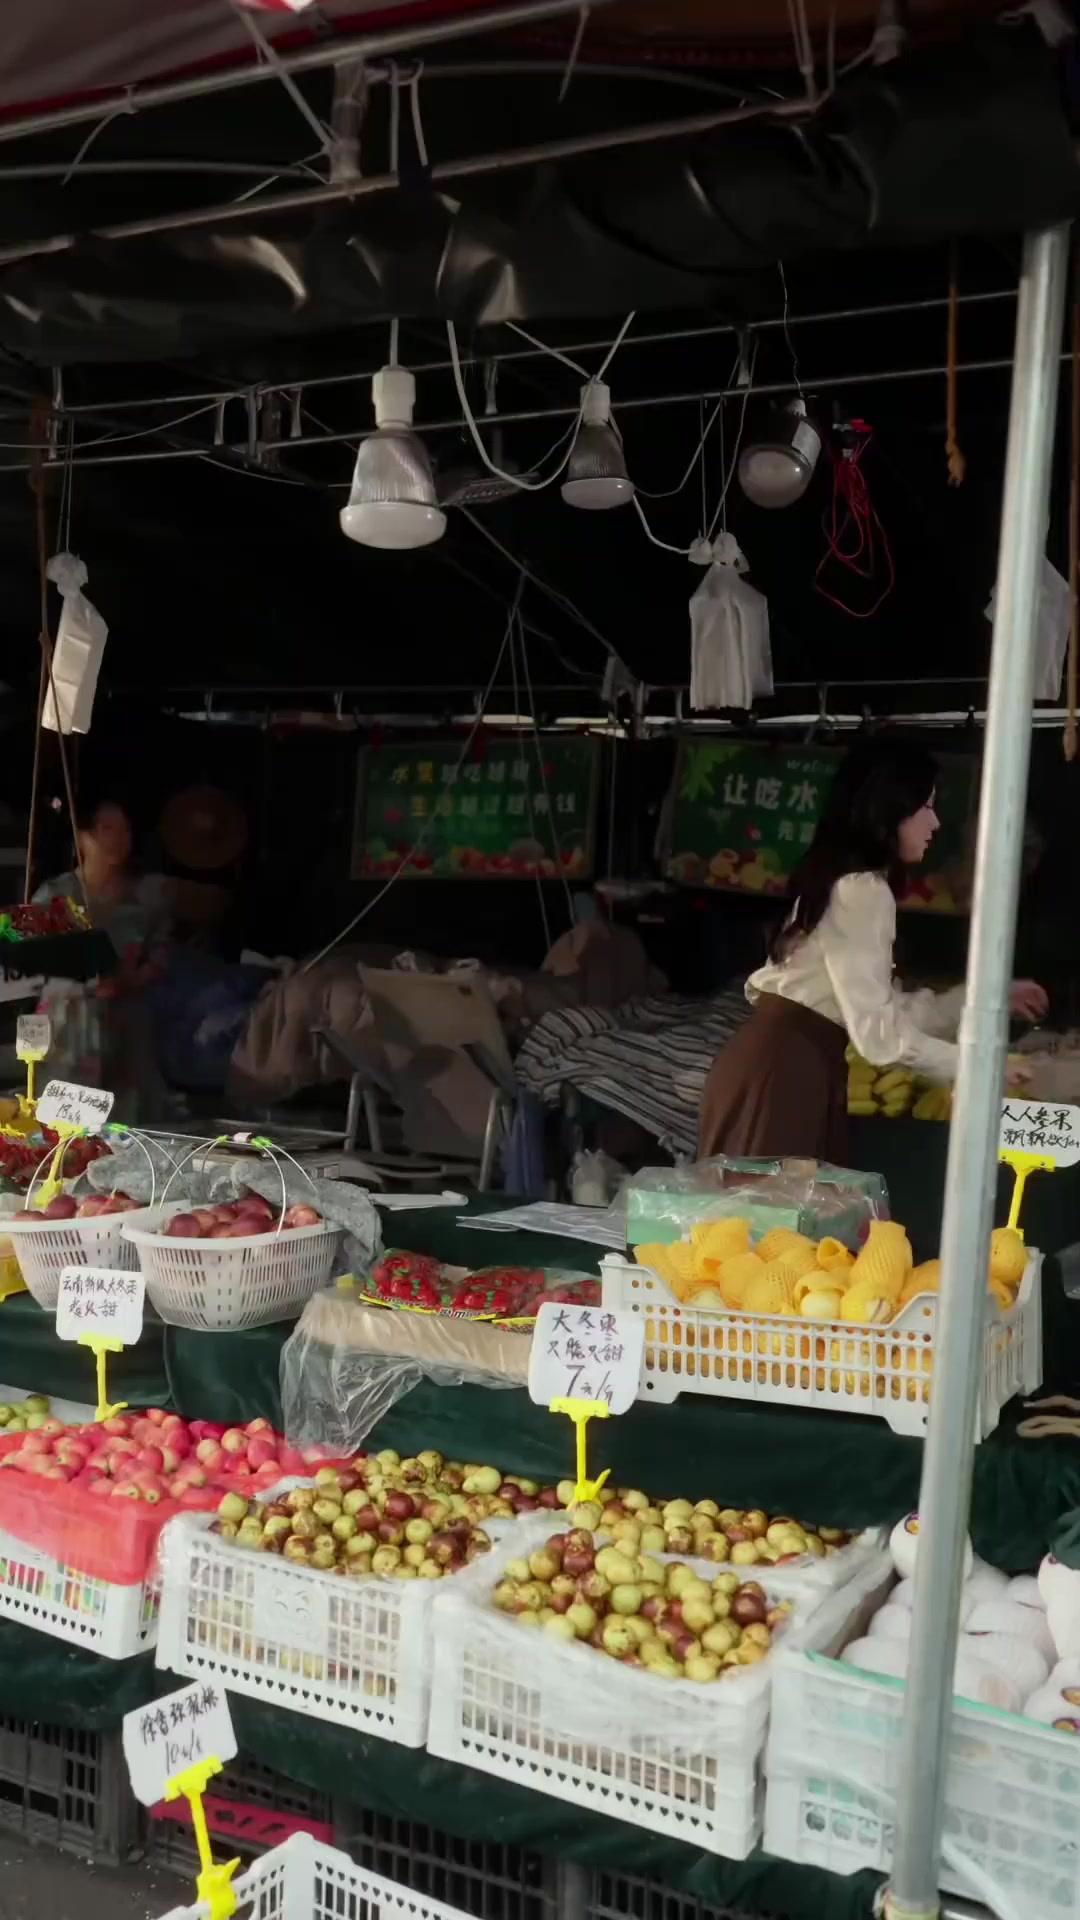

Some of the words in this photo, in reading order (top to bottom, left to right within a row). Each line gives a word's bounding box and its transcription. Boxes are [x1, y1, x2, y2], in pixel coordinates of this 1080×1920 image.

[723, 773, 818, 812] 让吃水
[547, 1338, 624, 1363] 又脆又甜
